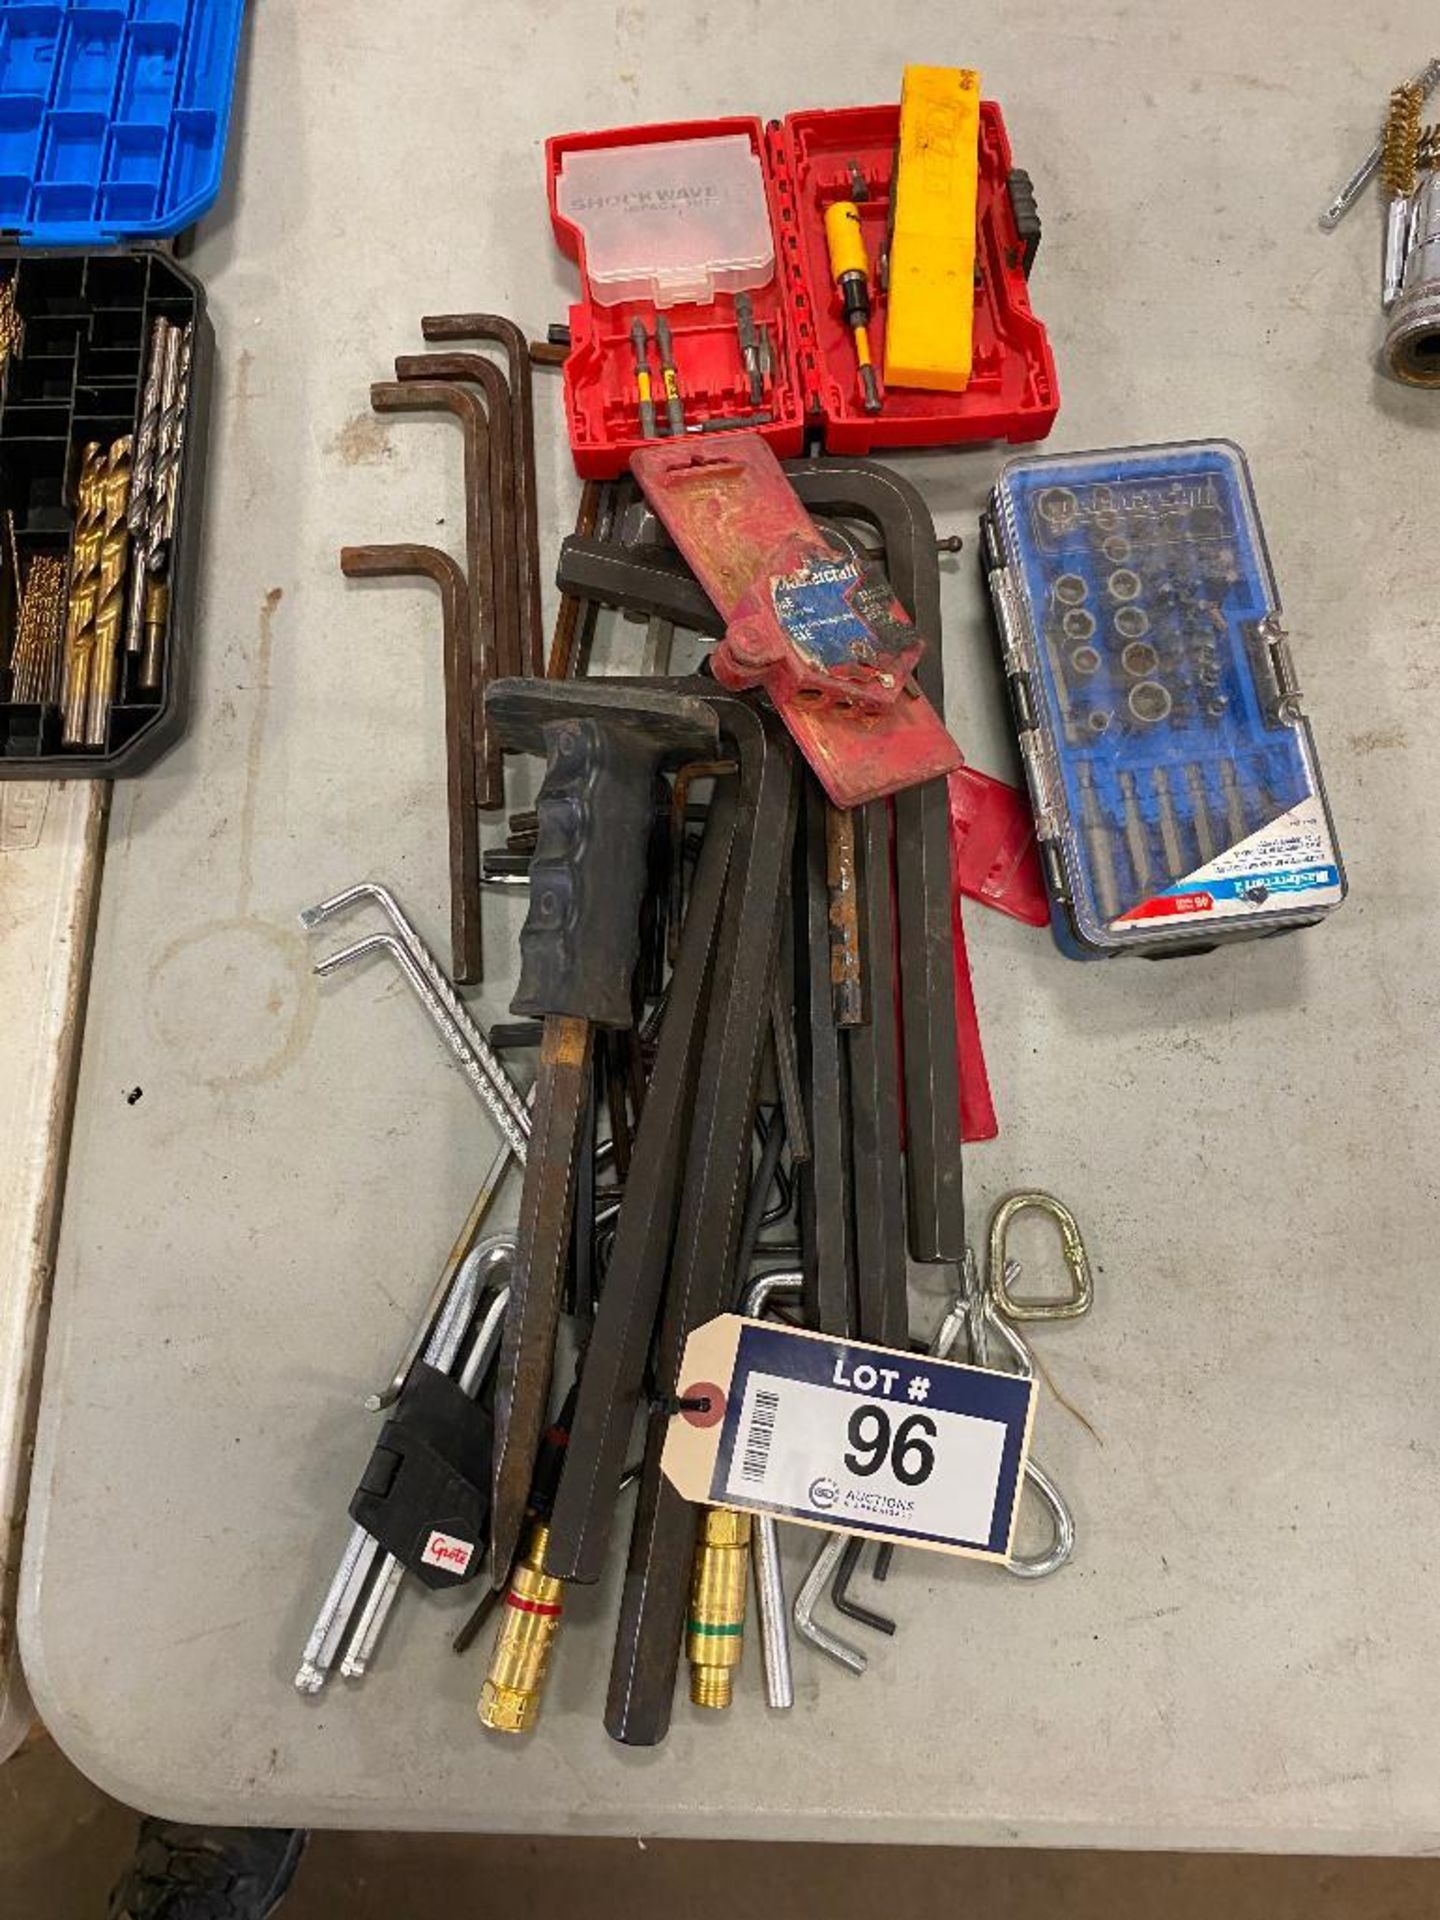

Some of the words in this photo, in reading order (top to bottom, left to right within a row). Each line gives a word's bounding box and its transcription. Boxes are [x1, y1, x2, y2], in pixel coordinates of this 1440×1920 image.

[832, 1359, 900, 1396] LOT
[907, 1375, 932, 1402] #
[843, 1404, 938, 1487] 96
[845, 1489, 916, 1511] AUCTIONS
